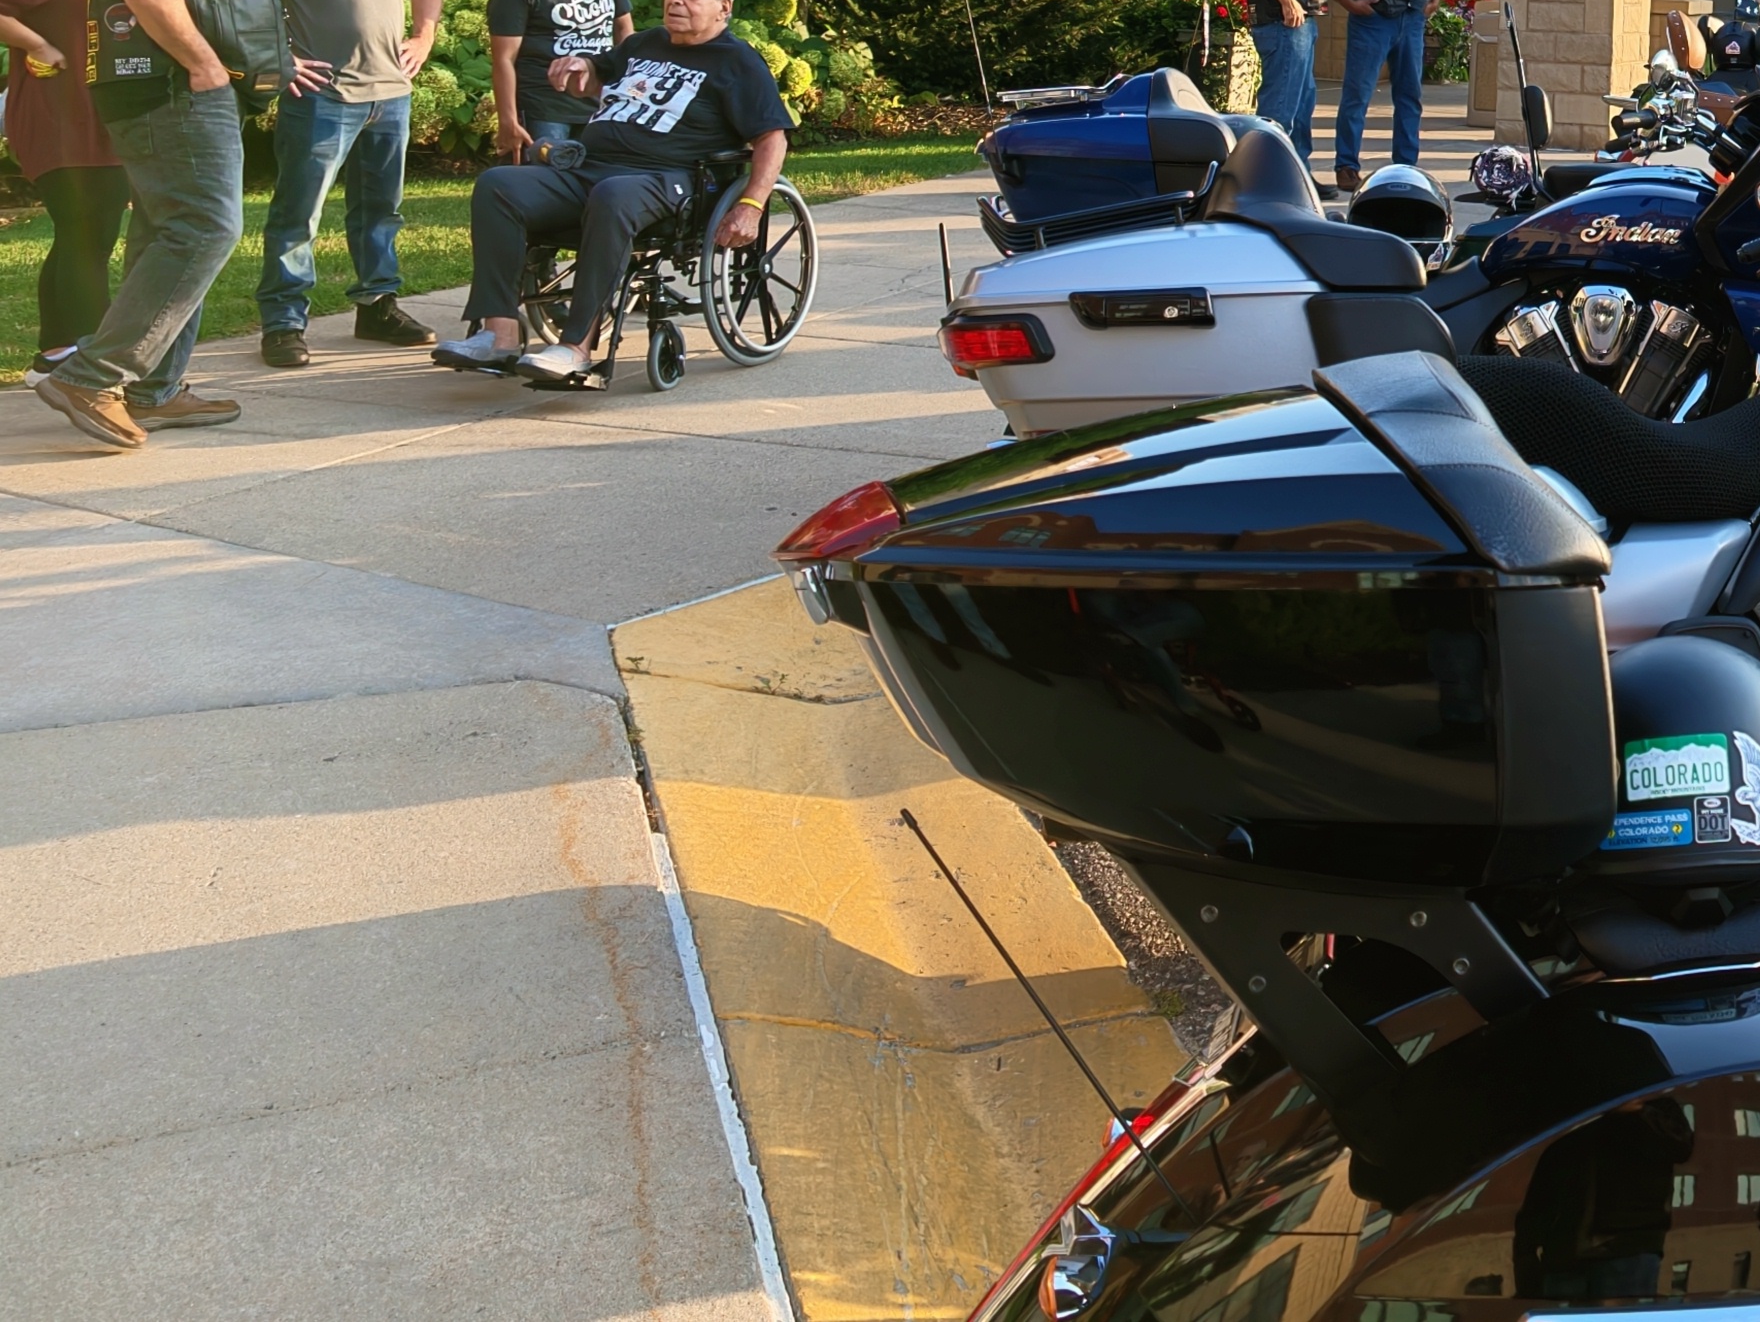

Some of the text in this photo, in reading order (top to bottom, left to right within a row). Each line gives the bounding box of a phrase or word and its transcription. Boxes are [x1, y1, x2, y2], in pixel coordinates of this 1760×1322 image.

[1580, 215, 1683, 245] Indian
[1629, 761, 1724, 790] COLORADO
[1664, 813, 1688, 823] PASS
[1618, 825, 1669, 837] COLORADO
